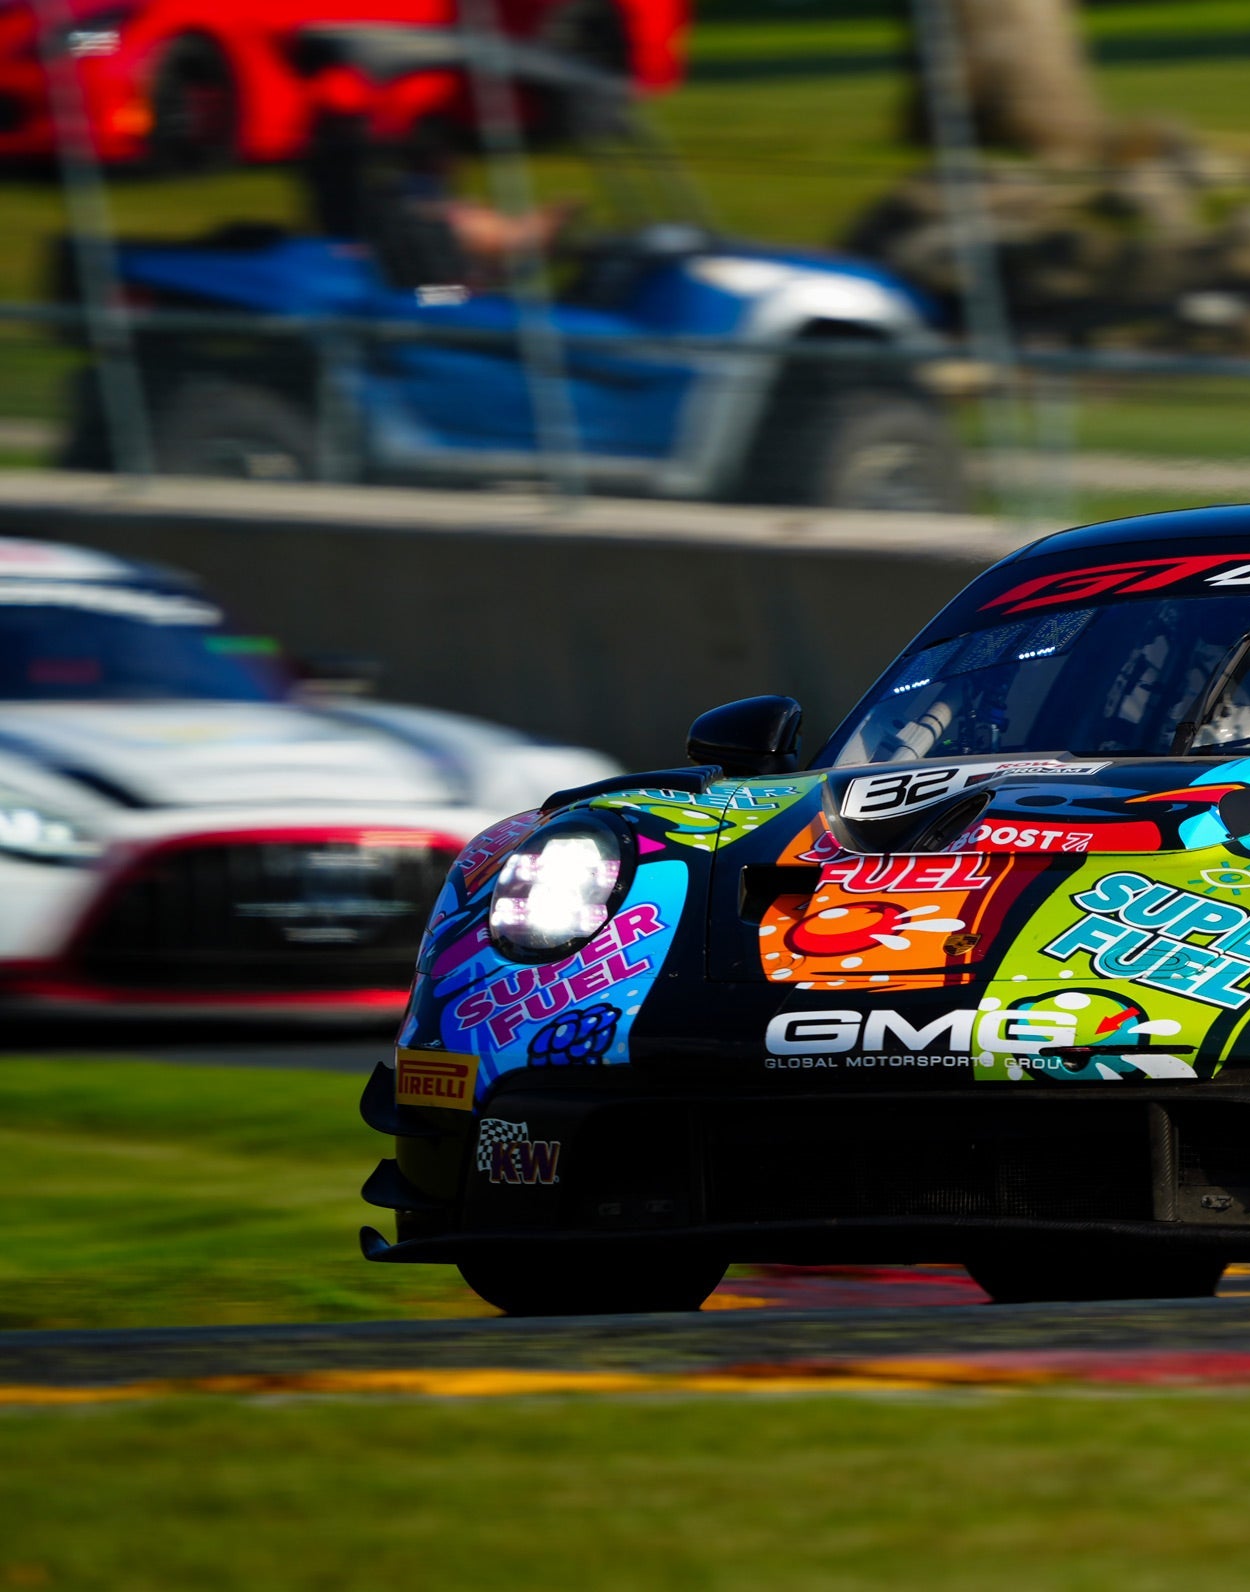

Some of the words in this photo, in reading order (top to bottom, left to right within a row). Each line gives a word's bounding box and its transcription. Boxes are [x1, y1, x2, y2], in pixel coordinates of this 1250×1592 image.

[859, 768, 960, 813] 32
[815, 851, 993, 893] FUEL
[486, 952, 651, 1048] FUEL
[765, 1009, 1079, 1056] GMG
[397, 1059, 469, 1099] PIRELLI
[764, 1057, 838, 1070] GLOBAL
[1004, 1057, 1062, 1070] GROU
[489, 1140, 561, 1185] KW
